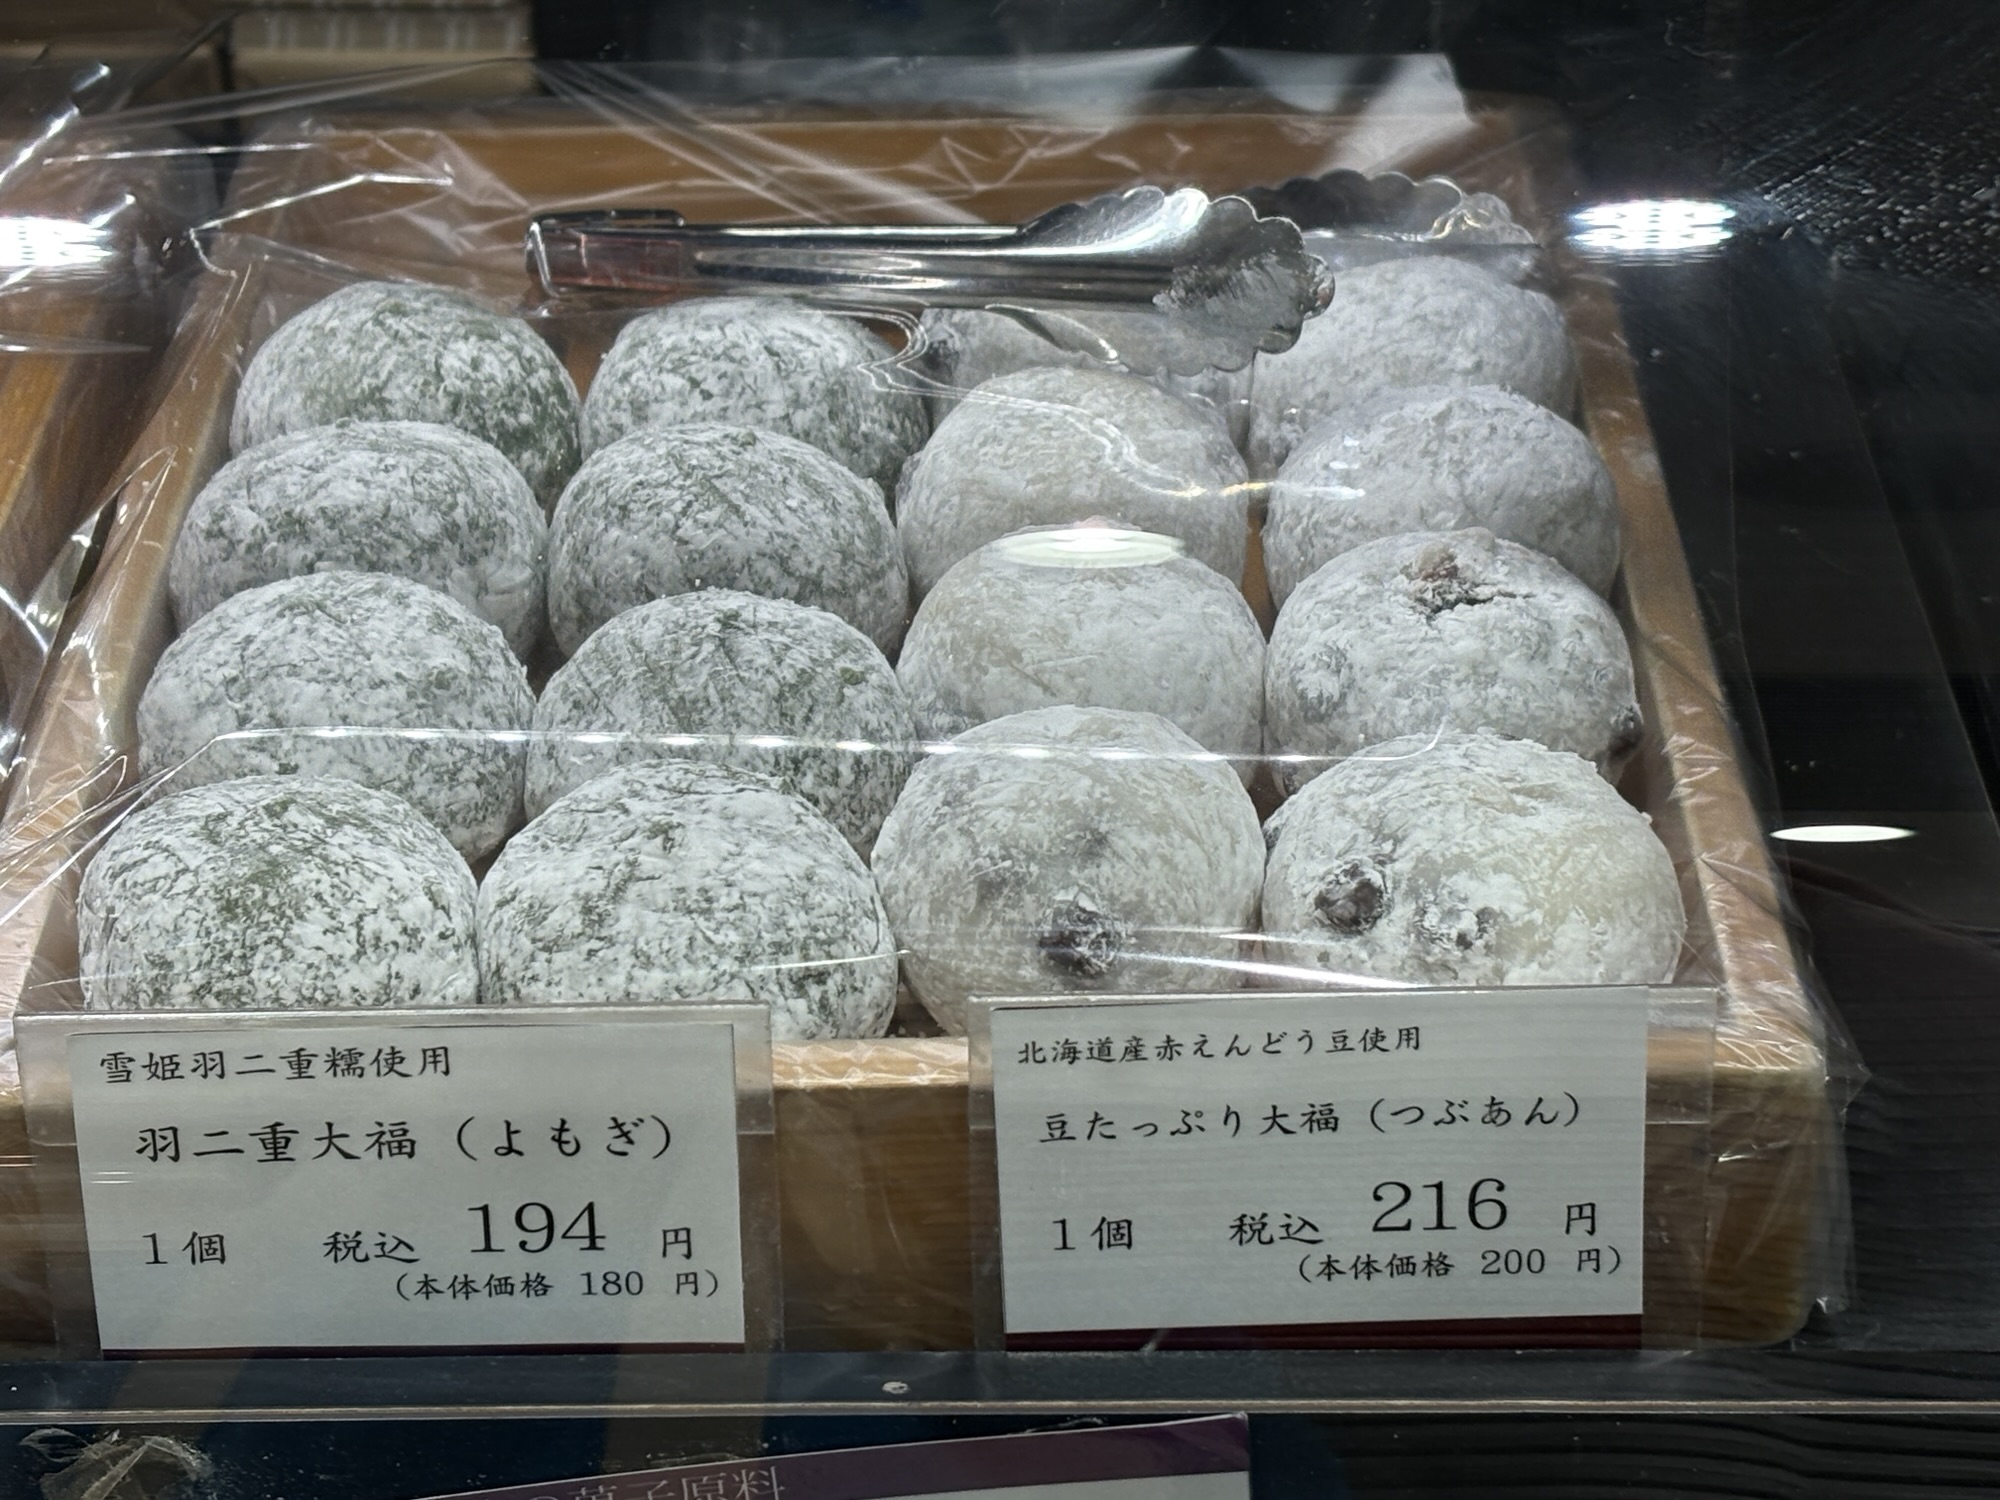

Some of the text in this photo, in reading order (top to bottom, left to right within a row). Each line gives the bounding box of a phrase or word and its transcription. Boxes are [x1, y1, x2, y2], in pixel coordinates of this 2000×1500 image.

[99, 1045, 451, 1084] 雪姫羽二重糯使用
[1017, 1025, 1420, 1066] 北海道産赤えんどう豆使用
[142, 1201, 693, 1266] 1個 税込 194 円
[1052, 1177, 1597, 1252] 1個 税込 216 円
[1480, 1248, 1546, 1275] 200
[580, 1270, 644, 1297] 180
